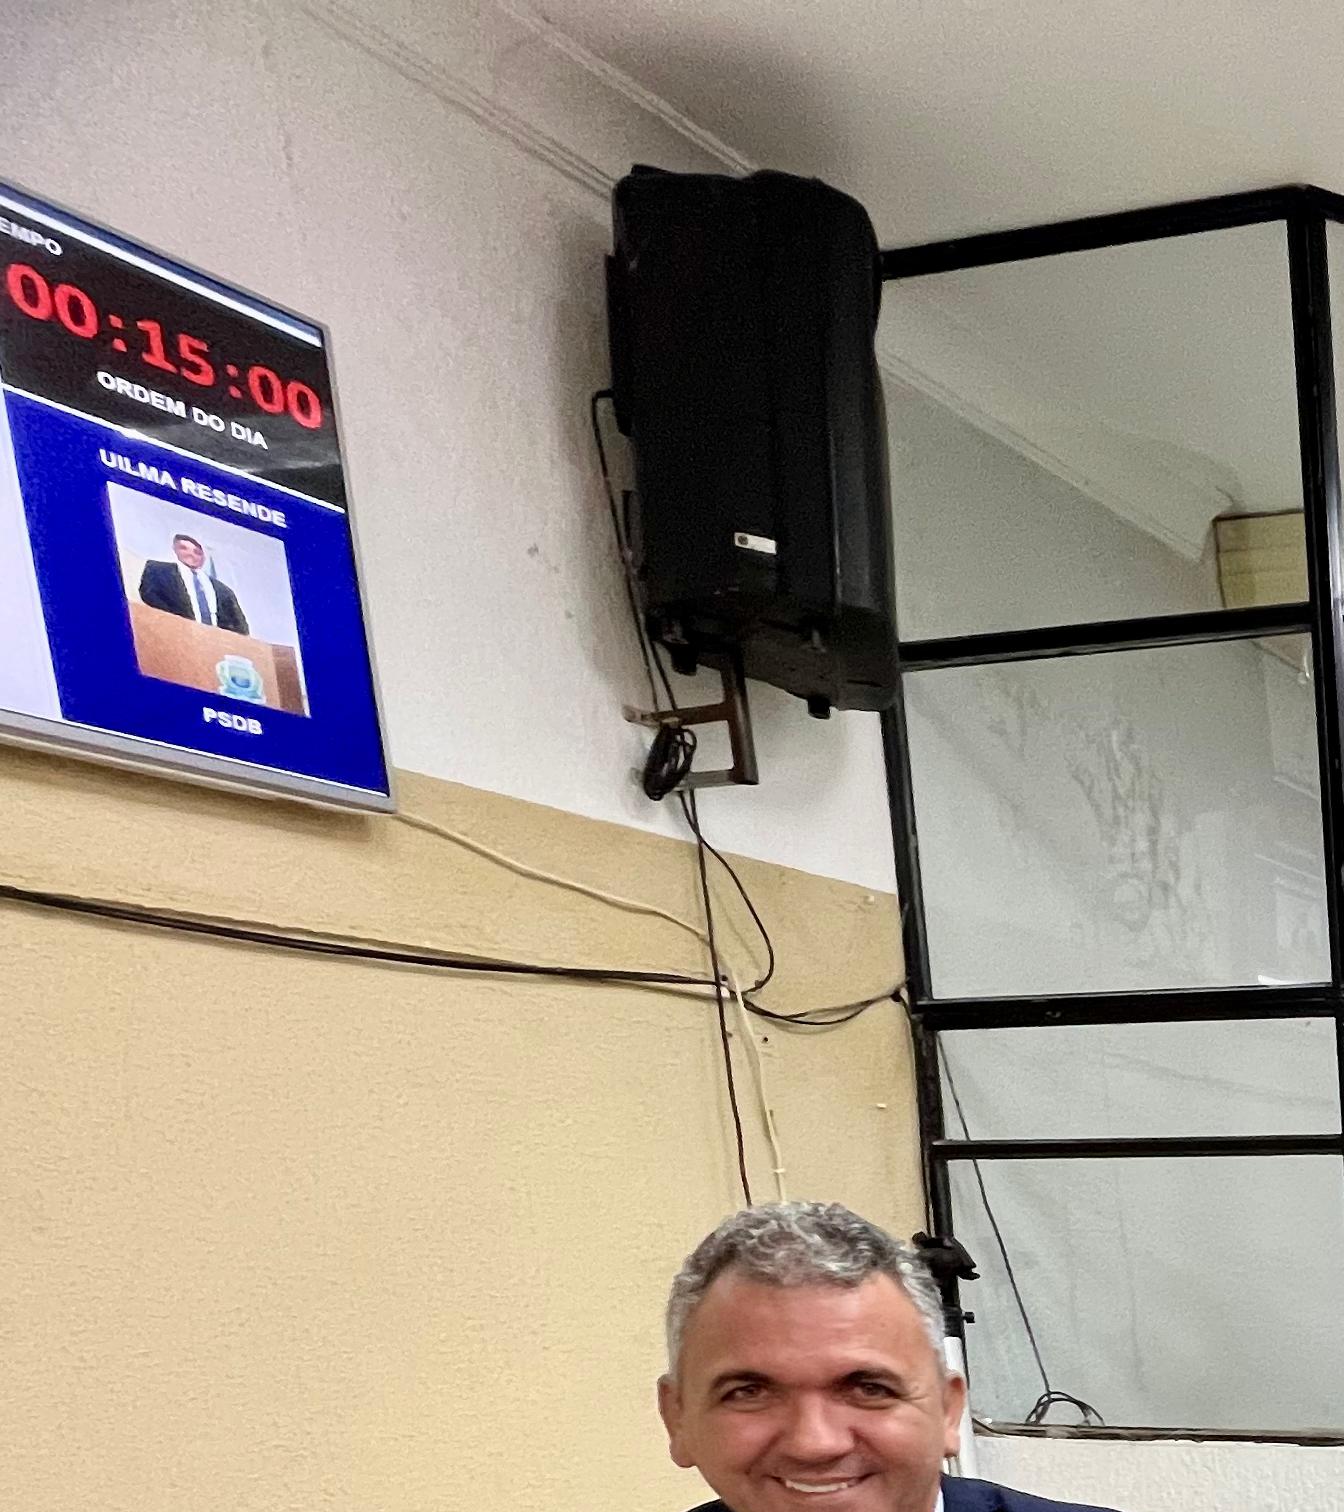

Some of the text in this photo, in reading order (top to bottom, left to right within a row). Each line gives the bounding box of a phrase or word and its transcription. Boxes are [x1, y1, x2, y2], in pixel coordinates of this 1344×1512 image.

[0, 217, 63, 256] EMPO
[7, 263, 322, 429] 00:15:00
[96, 370, 269, 450] ORDEM DO DIA
[99, 448, 288, 528] UILMA RESENDE
[202, 706, 264, 735] PSDB
